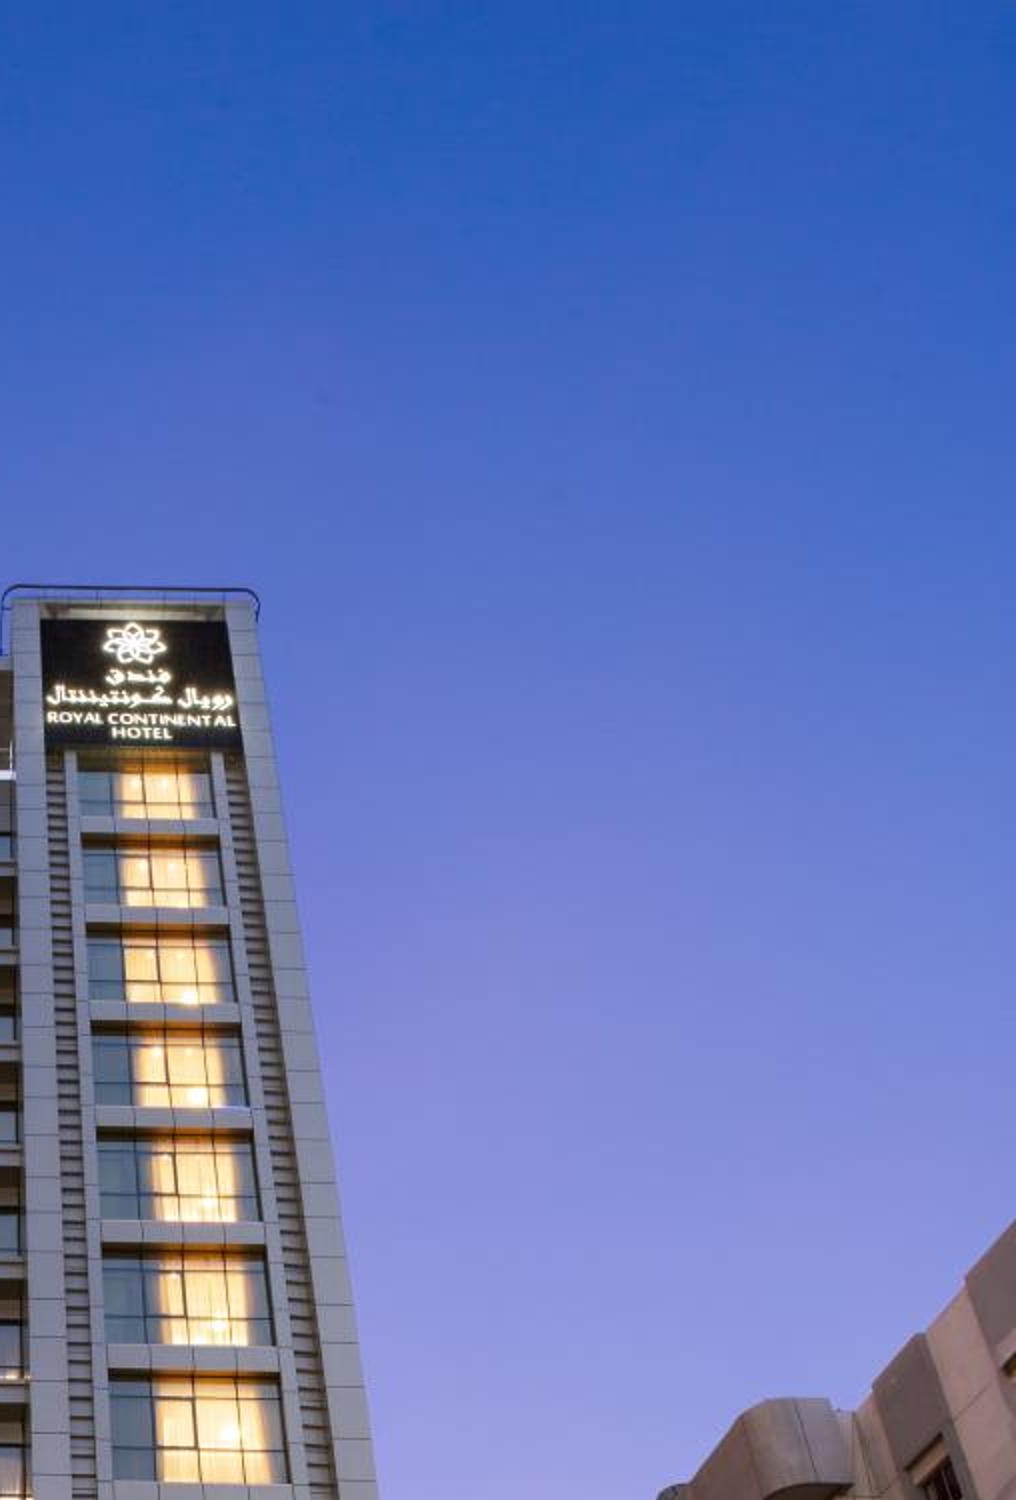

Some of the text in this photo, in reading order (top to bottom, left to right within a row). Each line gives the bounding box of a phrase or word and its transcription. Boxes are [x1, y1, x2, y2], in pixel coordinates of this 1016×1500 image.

[46, 710, 237, 727] ROYAL CONTINENTAL
[111, 727, 173, 741] HOTEL
